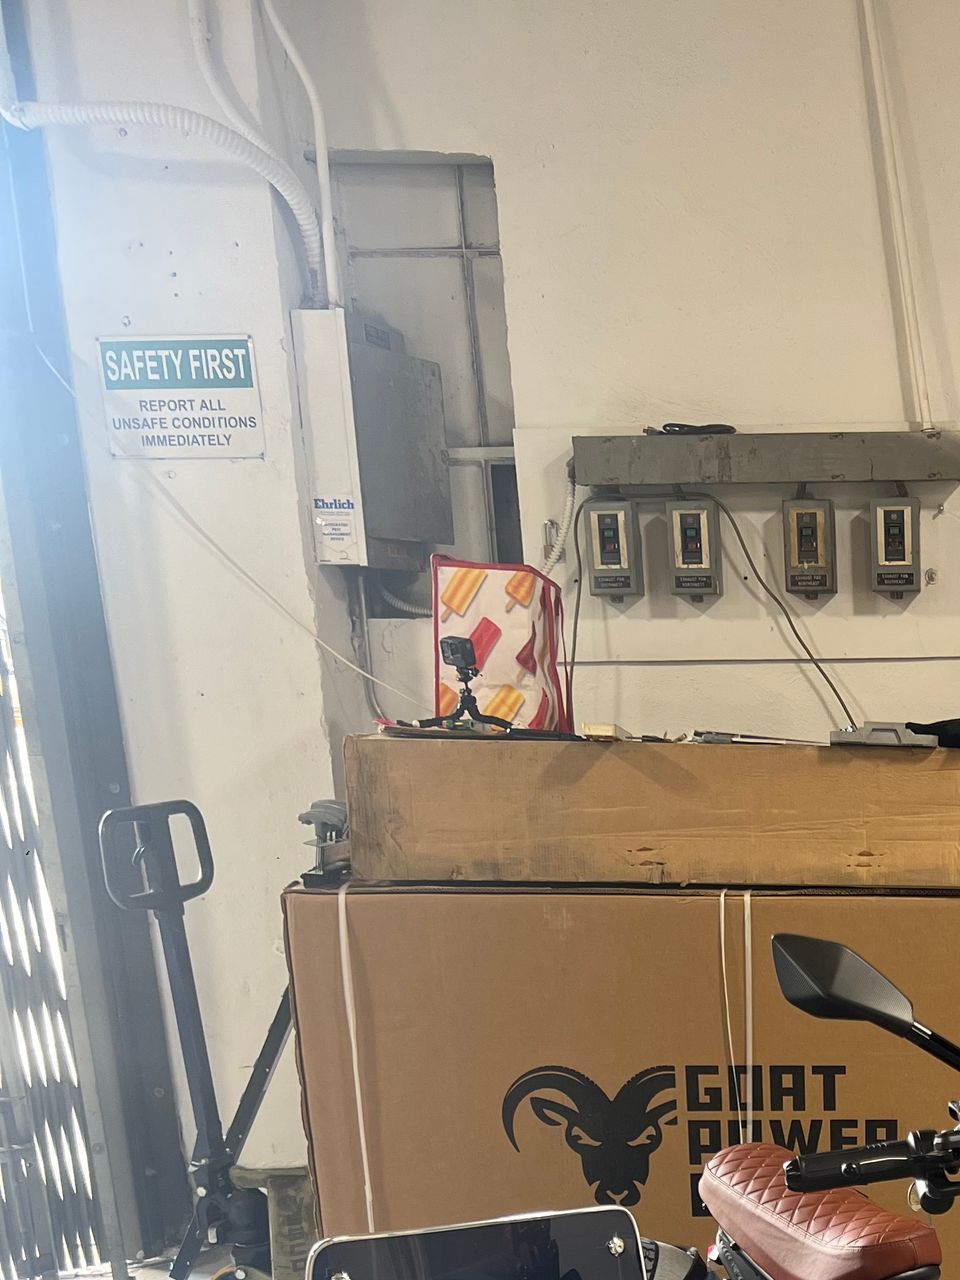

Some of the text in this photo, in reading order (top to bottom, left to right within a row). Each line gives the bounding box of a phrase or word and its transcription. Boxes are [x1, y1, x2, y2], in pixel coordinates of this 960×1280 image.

[105, 348, 246, 381] SAFETY FIRST
[139, 399, 226, 412] REPORT ALL
[112, 416, 257, 430] UNSAFE CONDITIONS
[141, 434, 232, 447] IMMEDIATELY
[313, 498, 355, 510] Ehrlich
[685, 1065, 847, 1112] GOAT
